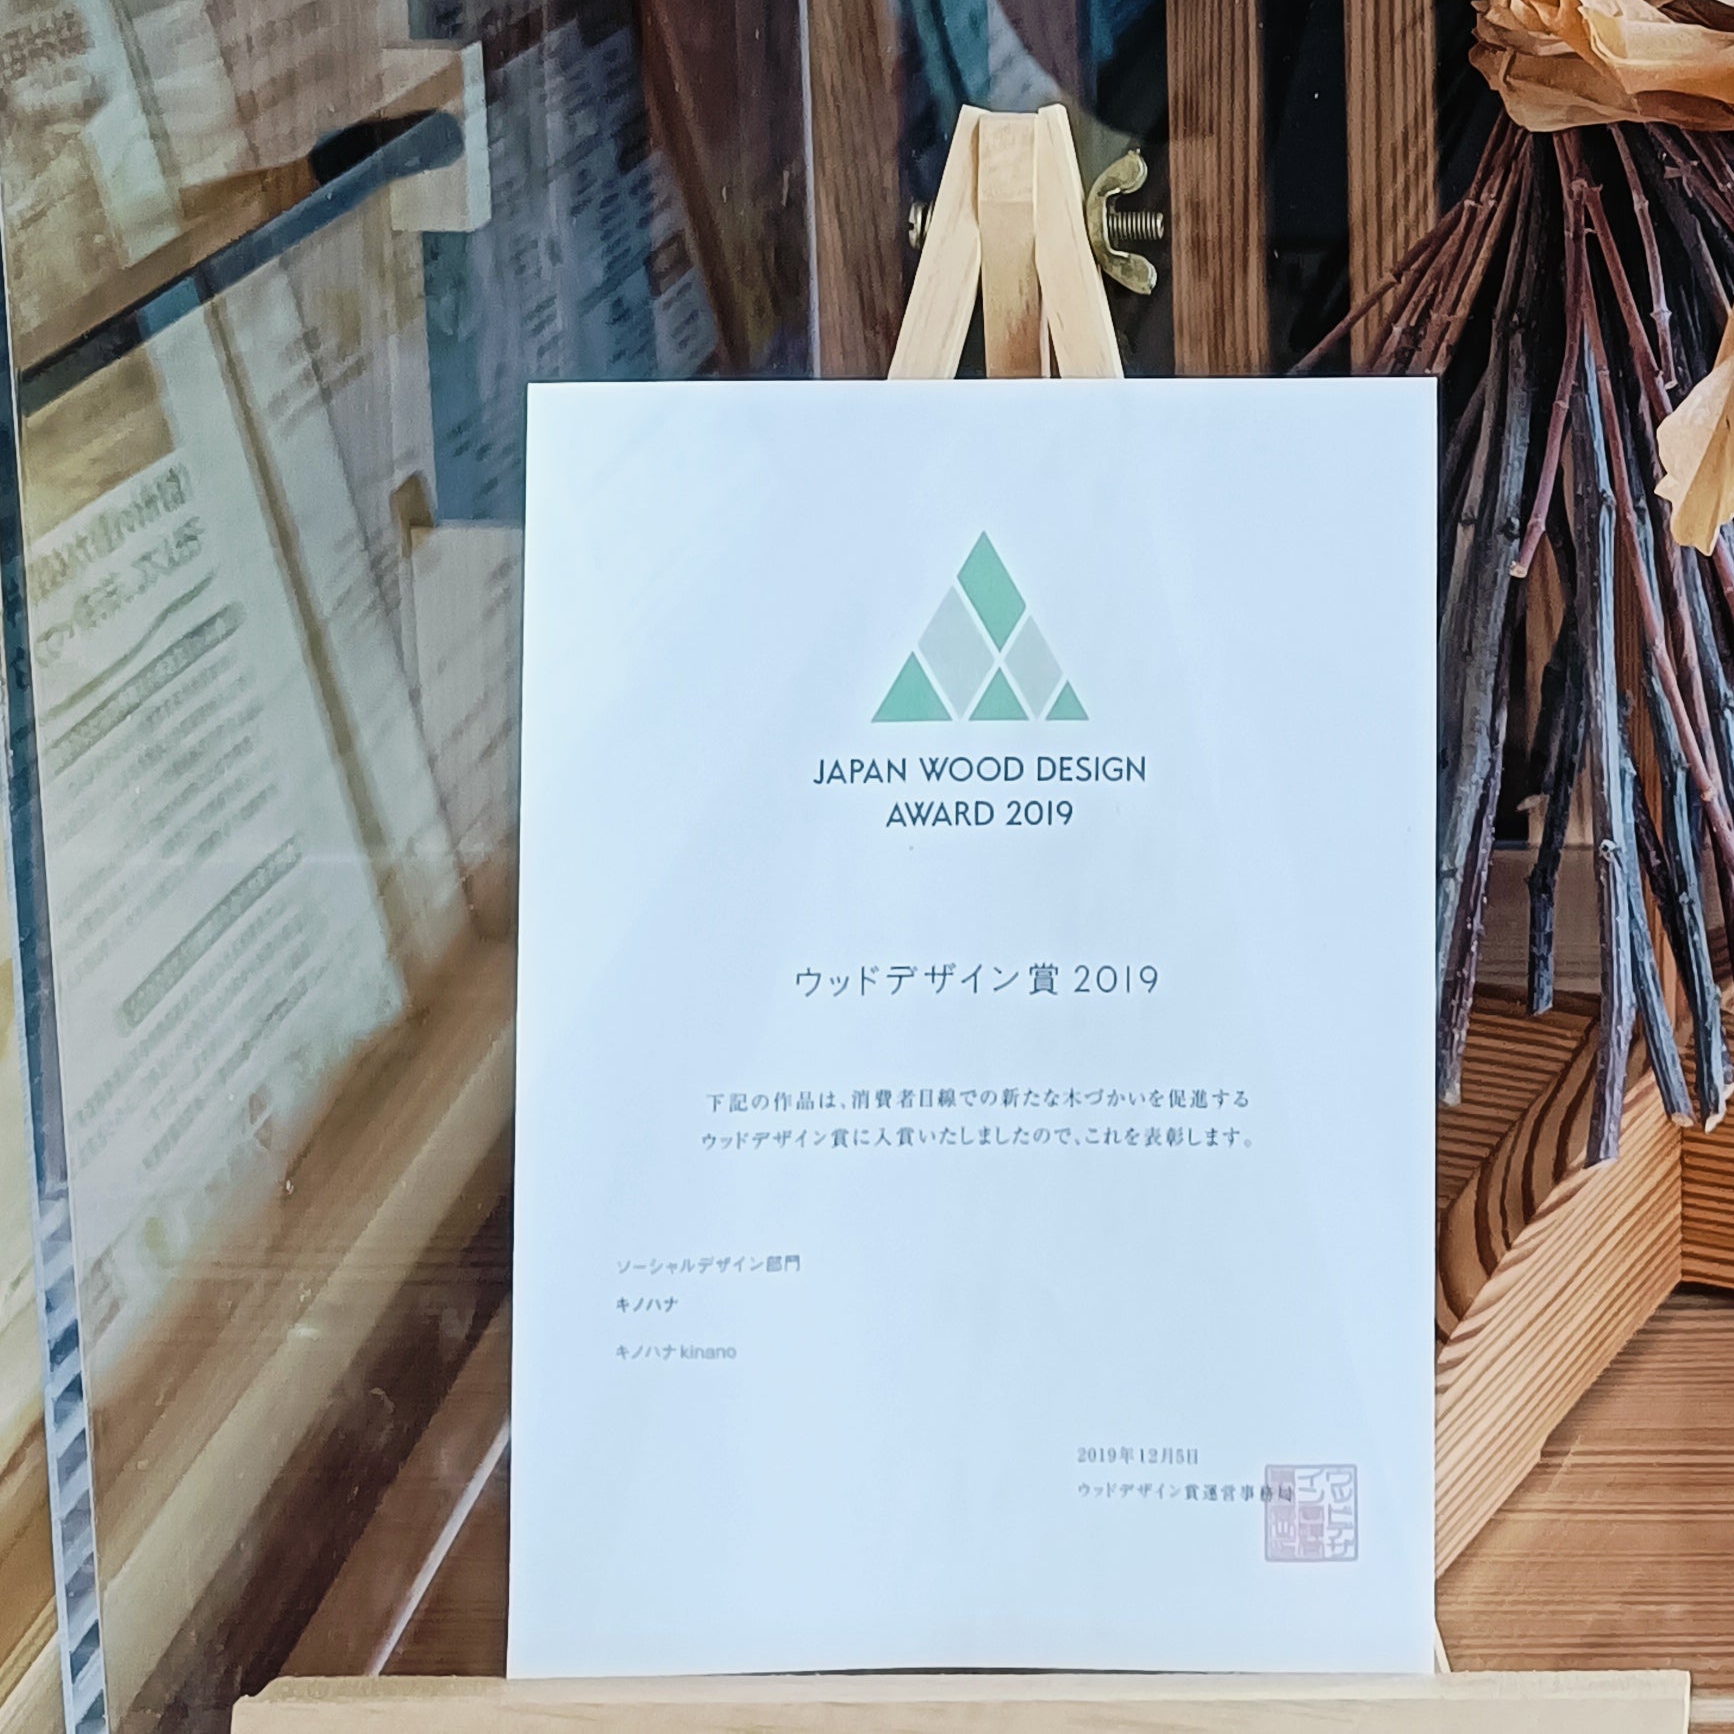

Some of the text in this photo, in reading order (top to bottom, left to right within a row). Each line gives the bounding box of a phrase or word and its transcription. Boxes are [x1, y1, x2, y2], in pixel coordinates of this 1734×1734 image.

[812, 756, 1147, 786] JAPAN WOOD DESIGN
[885, 800, 1075, 829] AWARD 2019
[794, 961, 1160, 998] ウッドデザイン賞 2019
[706, 1087, 1250, 1113] 下記の作品は、消費者目線での新たな木づかいを促進する
[701, 1125, 1254, 1151] ウッドデザイン賞に入賞いたしましたので、これを表彰します。
[616, 1254, 802, 1275] ソーシャルデザイン部門
[616, 1296, 679, 1314] キノハナ
[616, 1344, 738, 1362] キノハナ kinano
[1076, 1446, 1200, 1466] 2019年12月5日
